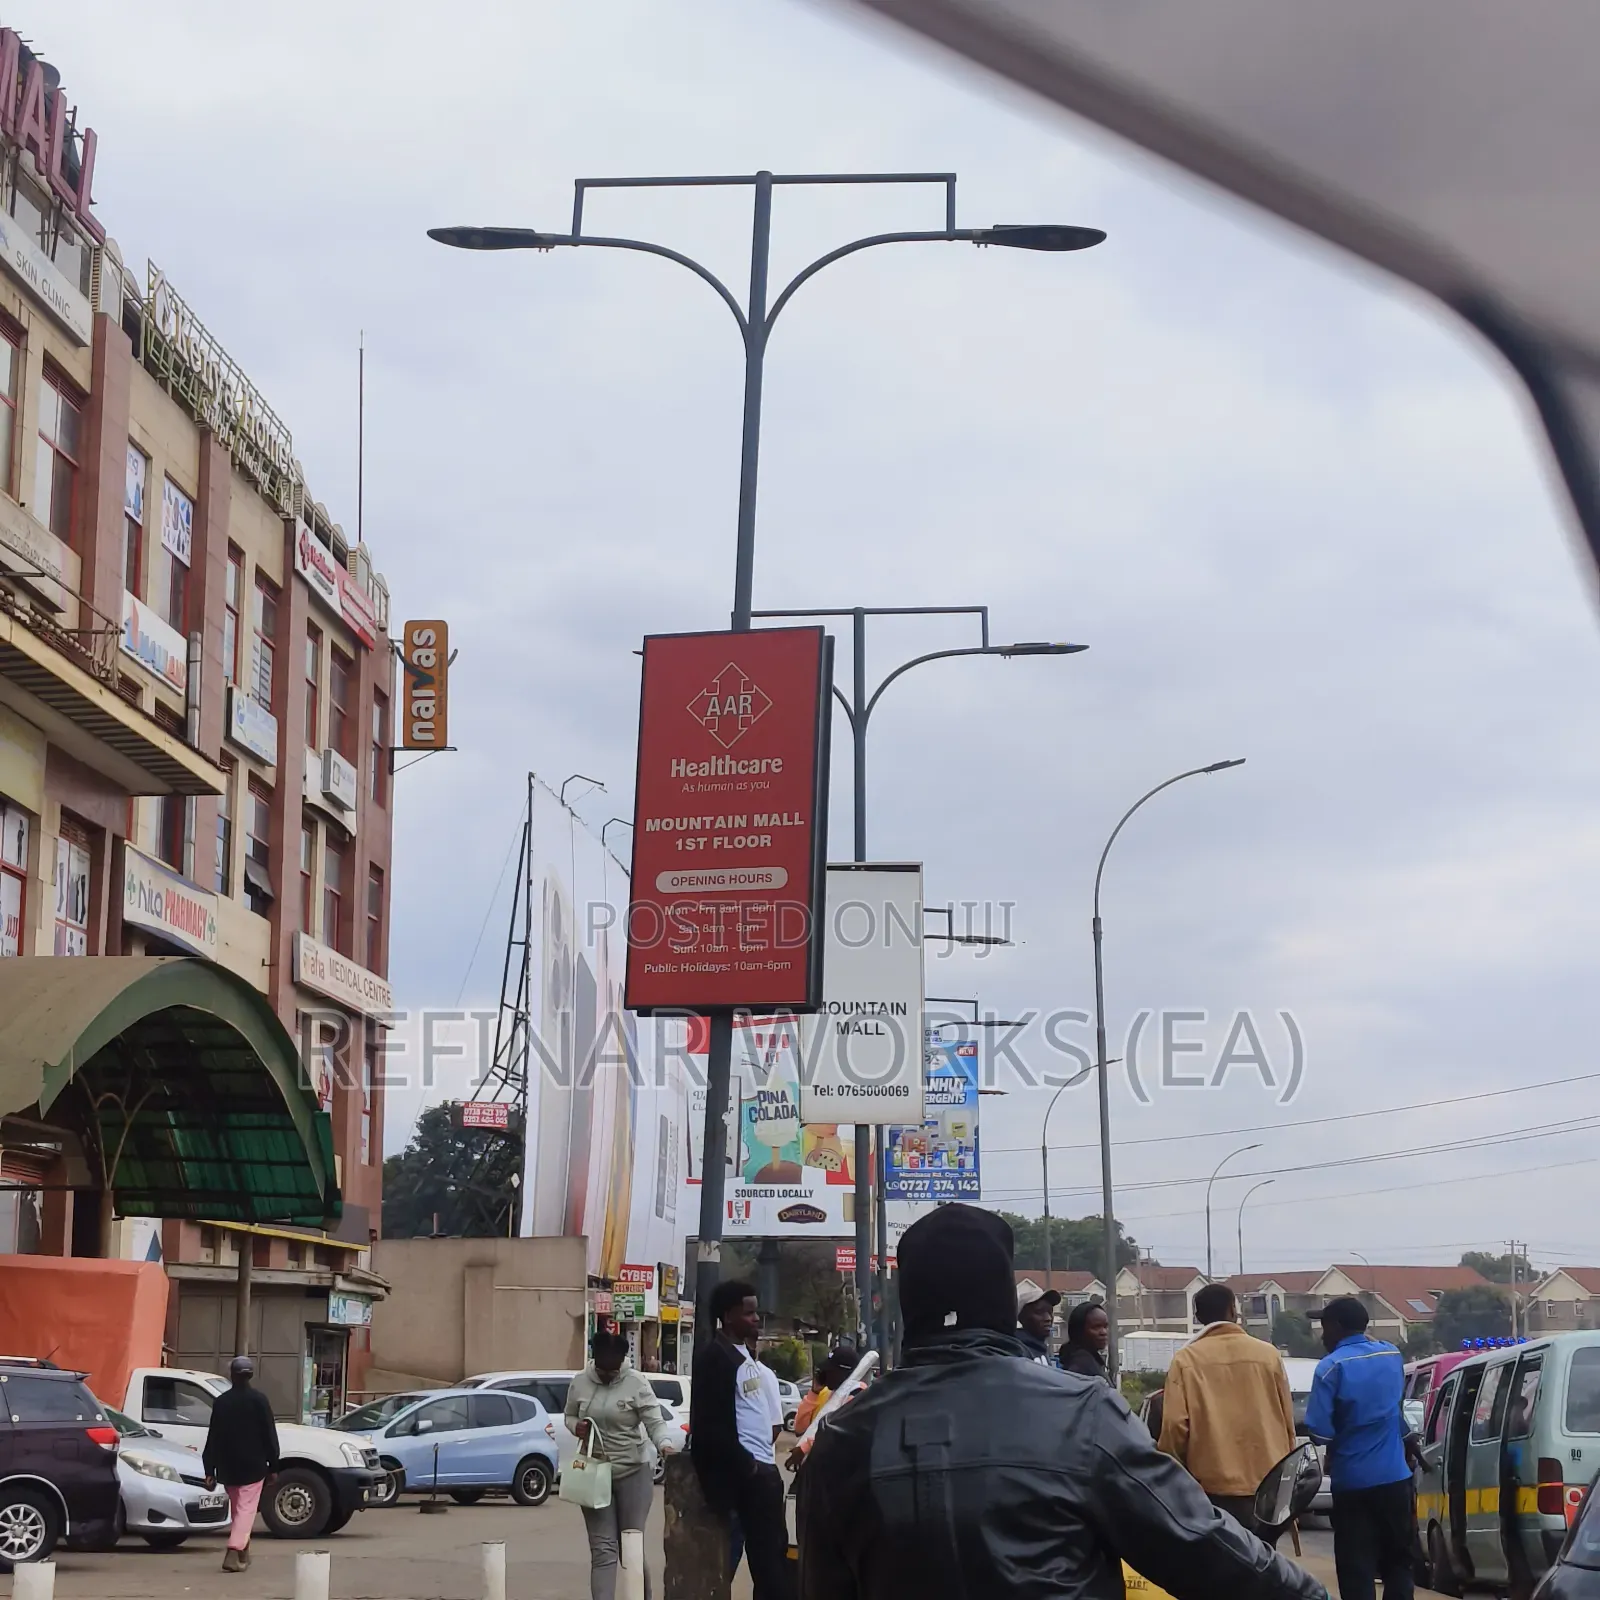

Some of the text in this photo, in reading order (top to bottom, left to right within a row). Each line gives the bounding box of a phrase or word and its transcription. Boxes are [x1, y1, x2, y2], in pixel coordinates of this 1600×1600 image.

[16, 250, 71, 319] SKIN CLINIC
[174, 303, 298, 484] Kenya Homes
[406, 628, 437, 742] naivas
[706, 694, 752, 716] AAR
[670, 755, 783, 778] Healthcare
[681, 780, 770, 793] As human as you
[645, 812, 805, 832] MOUNTAIN MALL
[675, 834, 772, 850] 1ST FLOOR
[671, 873, 773, 887] OPENING HOURS
[164, 887, 207, 941] PHARMACY
[664, 905, 688, 916] Mon
[673, 944, 697, 954] Sun:
[700, 943, 729, 953] 10am
[644, 960, 791, 973] Public Holidays: 10am-6pm
[329, 957, 362, 993] MEDICAL
[363, 978, 392, 1009] CENTRE
[836, 1021, 886, 1036] MALL
[812, 1084, 909, 1097] Tel: 0765000069
[926, 1092, 966, 1104] ERGENTS
[749, 1104, 799, 1124] COLADA
[734, 1188, 815, 1198] SOURCED LOCALLY
[900, 1180, 979, 1191] 0727 374 142
[781, 1208, 824, 1221] DAIRYLAND
[620, 1268, 653, 1283] CYBER
[1571, 1448, 1582, 1458] 80
